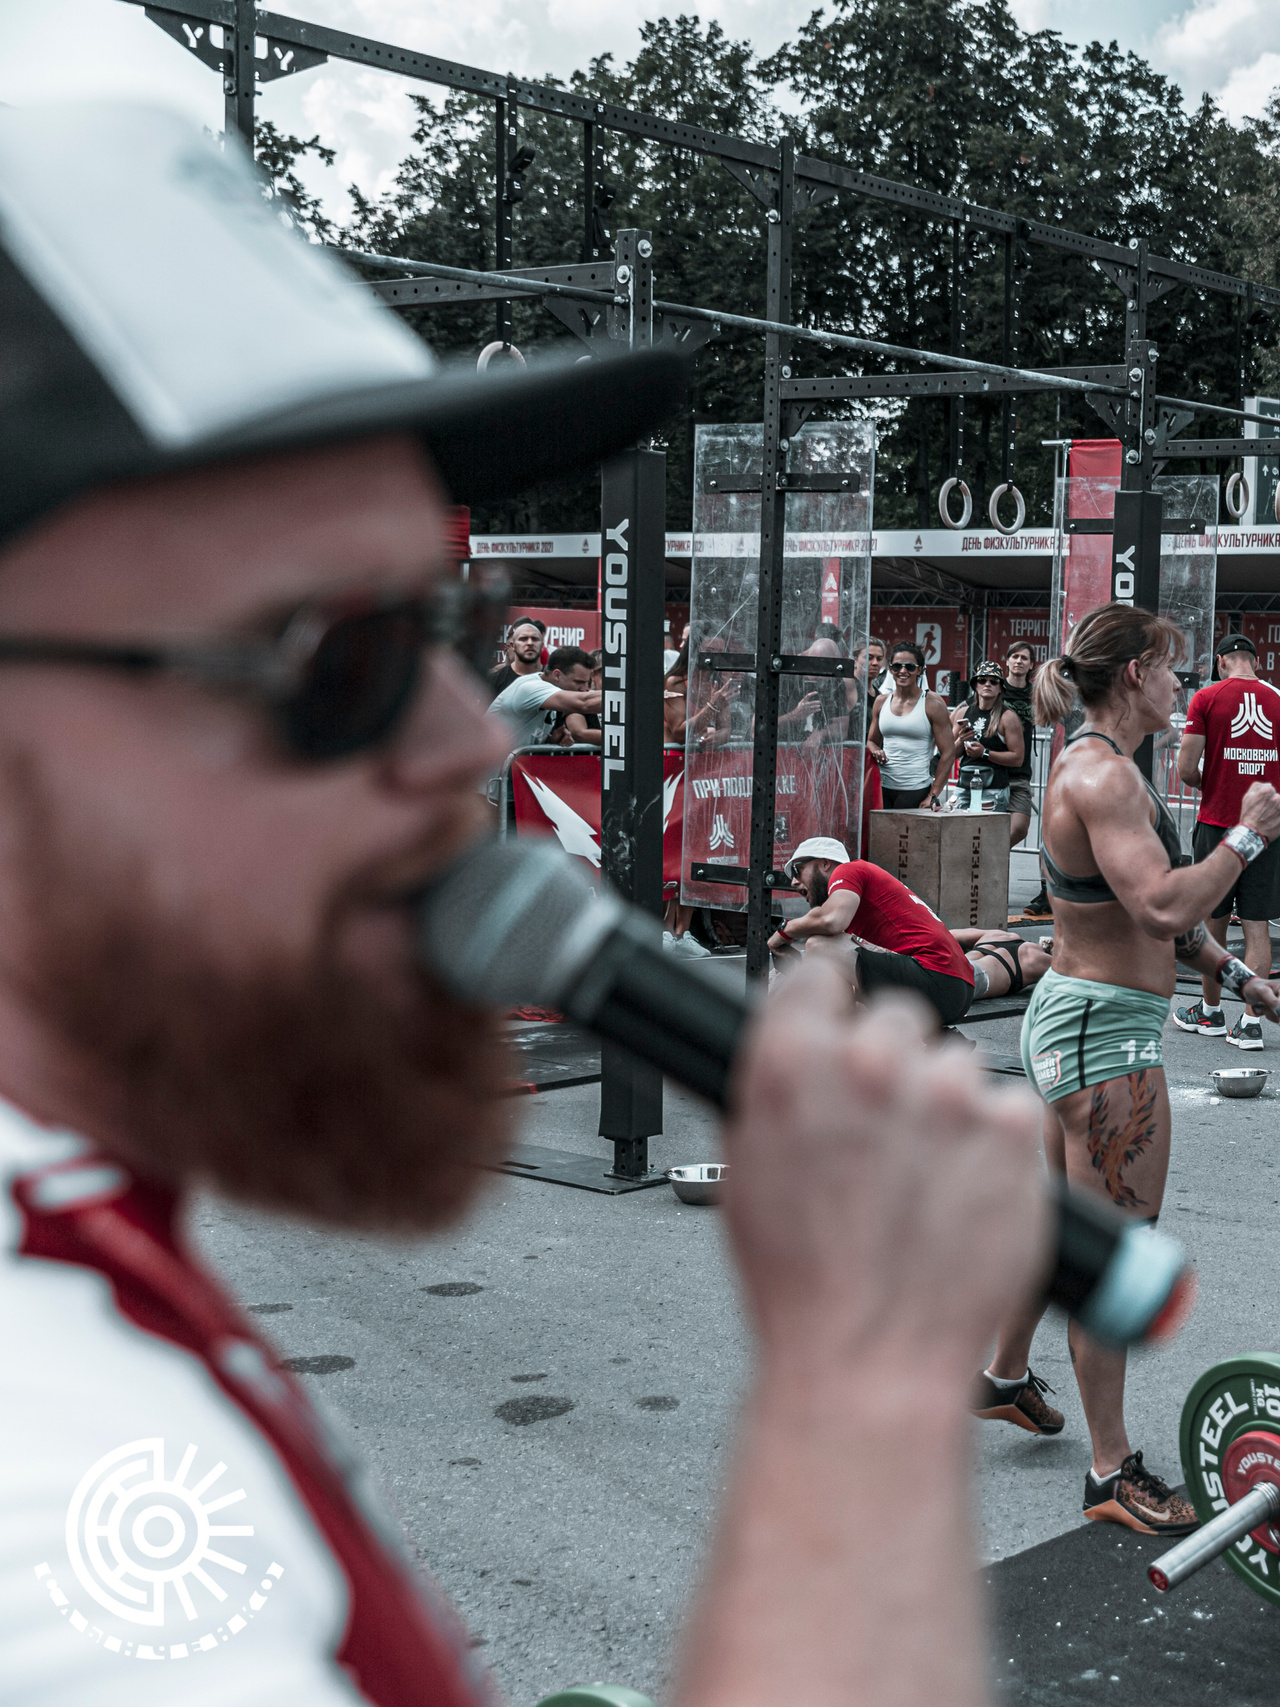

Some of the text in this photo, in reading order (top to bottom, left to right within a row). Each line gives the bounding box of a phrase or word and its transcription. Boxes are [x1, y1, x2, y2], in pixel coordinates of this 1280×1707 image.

[962, 537, 982, 552] ДЕНЬ
[983, 537, 1054, 550] ФИЗКУЛЬТУРНИКА
[1174, 534, 1196, 549] ДЕНЬ
[1198, 533, 1280, 548] ФИЗКУЛЬТУРНИКА
[544, 626, 585, 647] УРНИР
[604, 518, 630, 791] YOUSTEEL
[1266, 652, 1275, 671] В
[1223, 747, 1279, 762] МОСКОВСКИЙ
[1238, 762, 1266, 776] СПОРТ
[692, 778, 721, 799] ПРИ
[969, 827, 981, 926] OUSTEEL
[1255, 1388, 1266, 1408] KG
